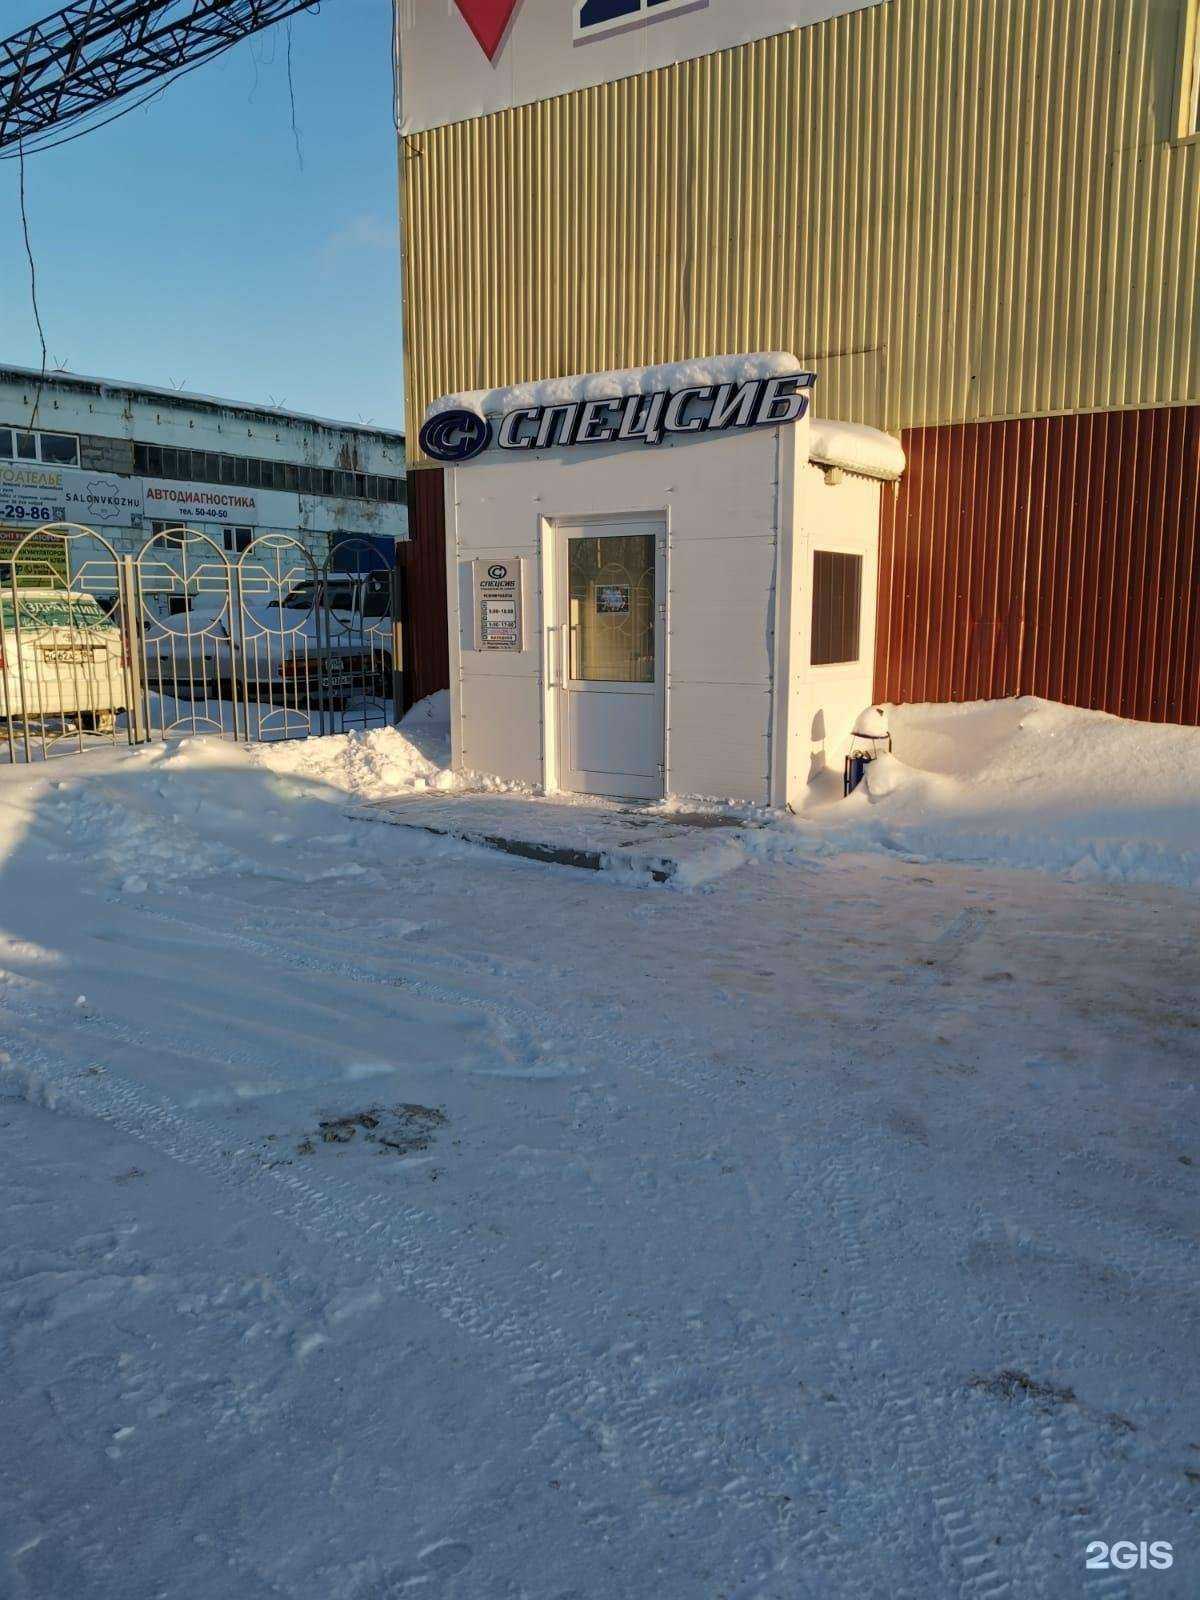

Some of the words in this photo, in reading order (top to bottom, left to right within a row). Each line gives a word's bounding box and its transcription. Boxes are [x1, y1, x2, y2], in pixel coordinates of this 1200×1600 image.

[497, 372, 816, 449] СПЕЦСИБ
[146, 488, 256, 508] АВТОДИАГНОСТИКА
[179, 508, 193, 516] тел.
[195, 508, 228, 518] 50-40-50
